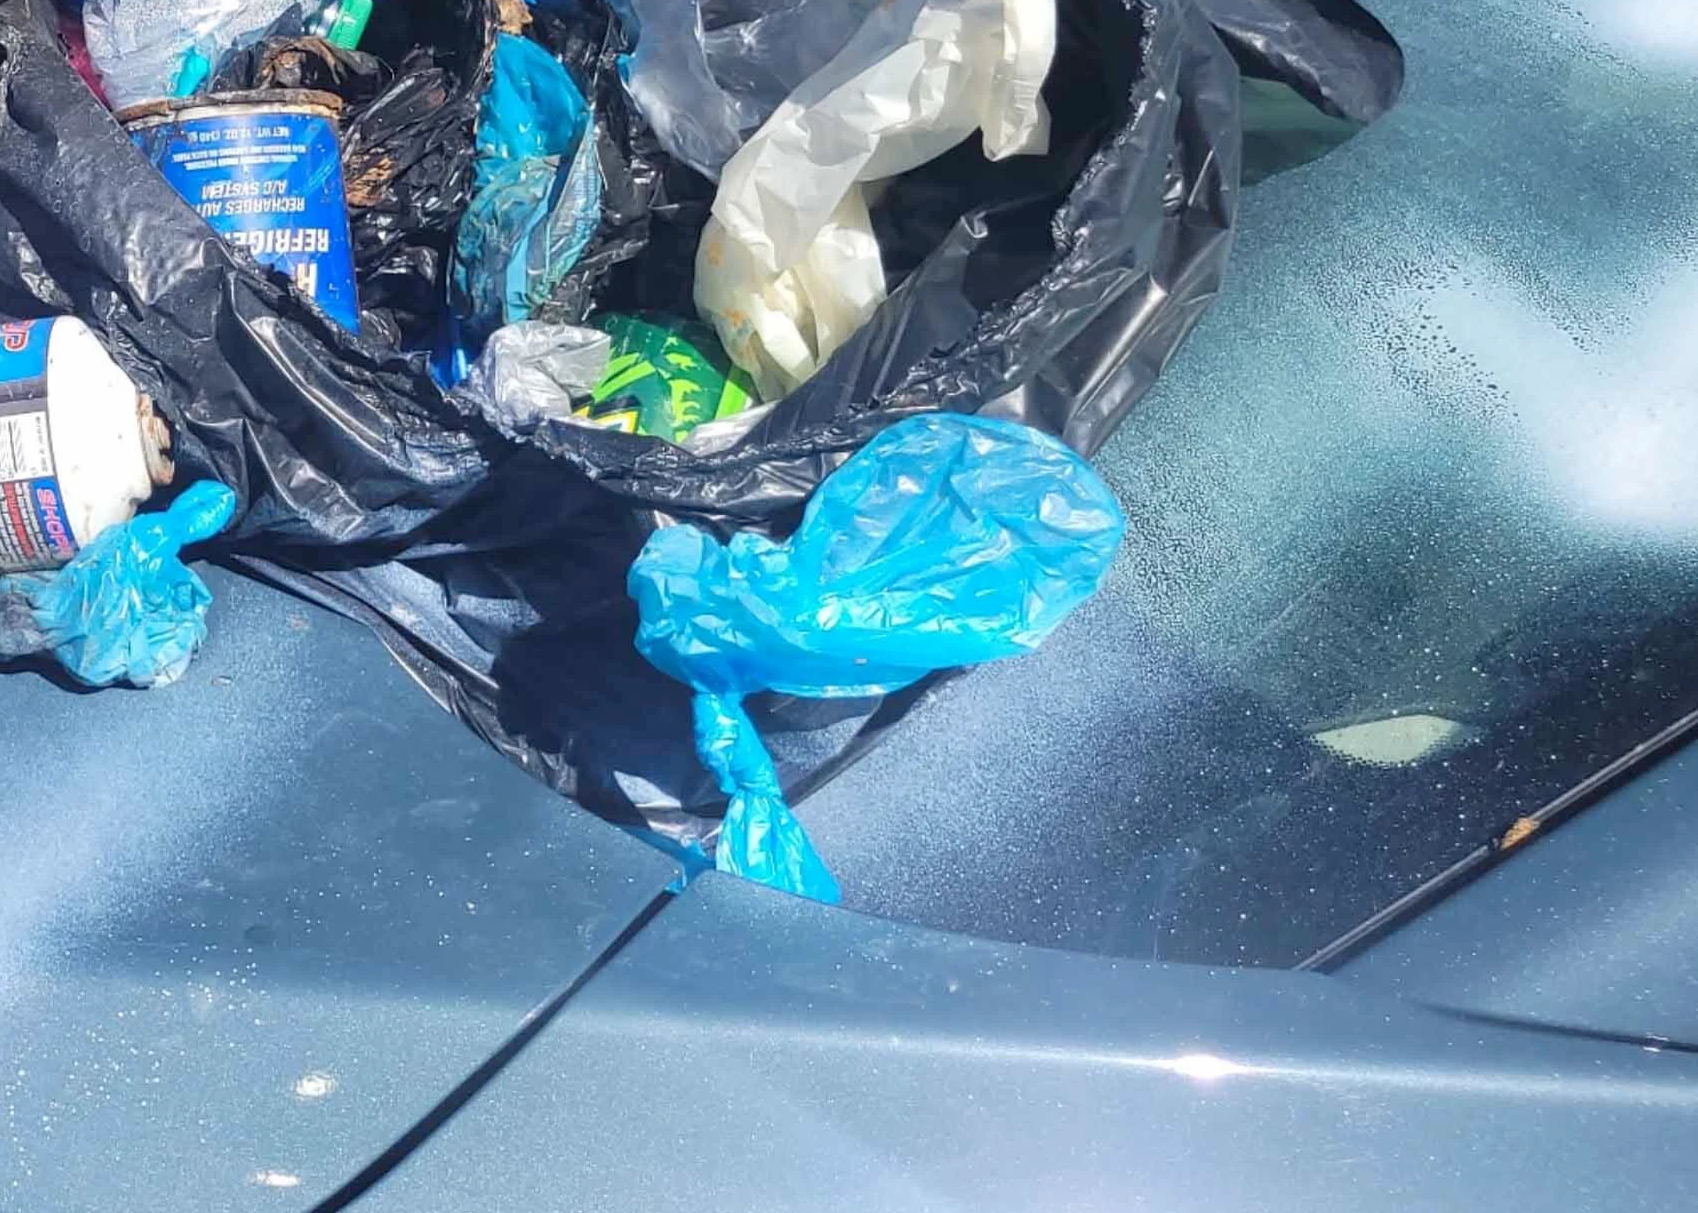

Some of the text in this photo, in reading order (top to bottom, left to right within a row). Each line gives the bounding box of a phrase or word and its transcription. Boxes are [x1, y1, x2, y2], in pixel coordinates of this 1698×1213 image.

[202, 179, 288, 199] A/C SYSTEM
[225, 197, 306, 215] RECHARGES
